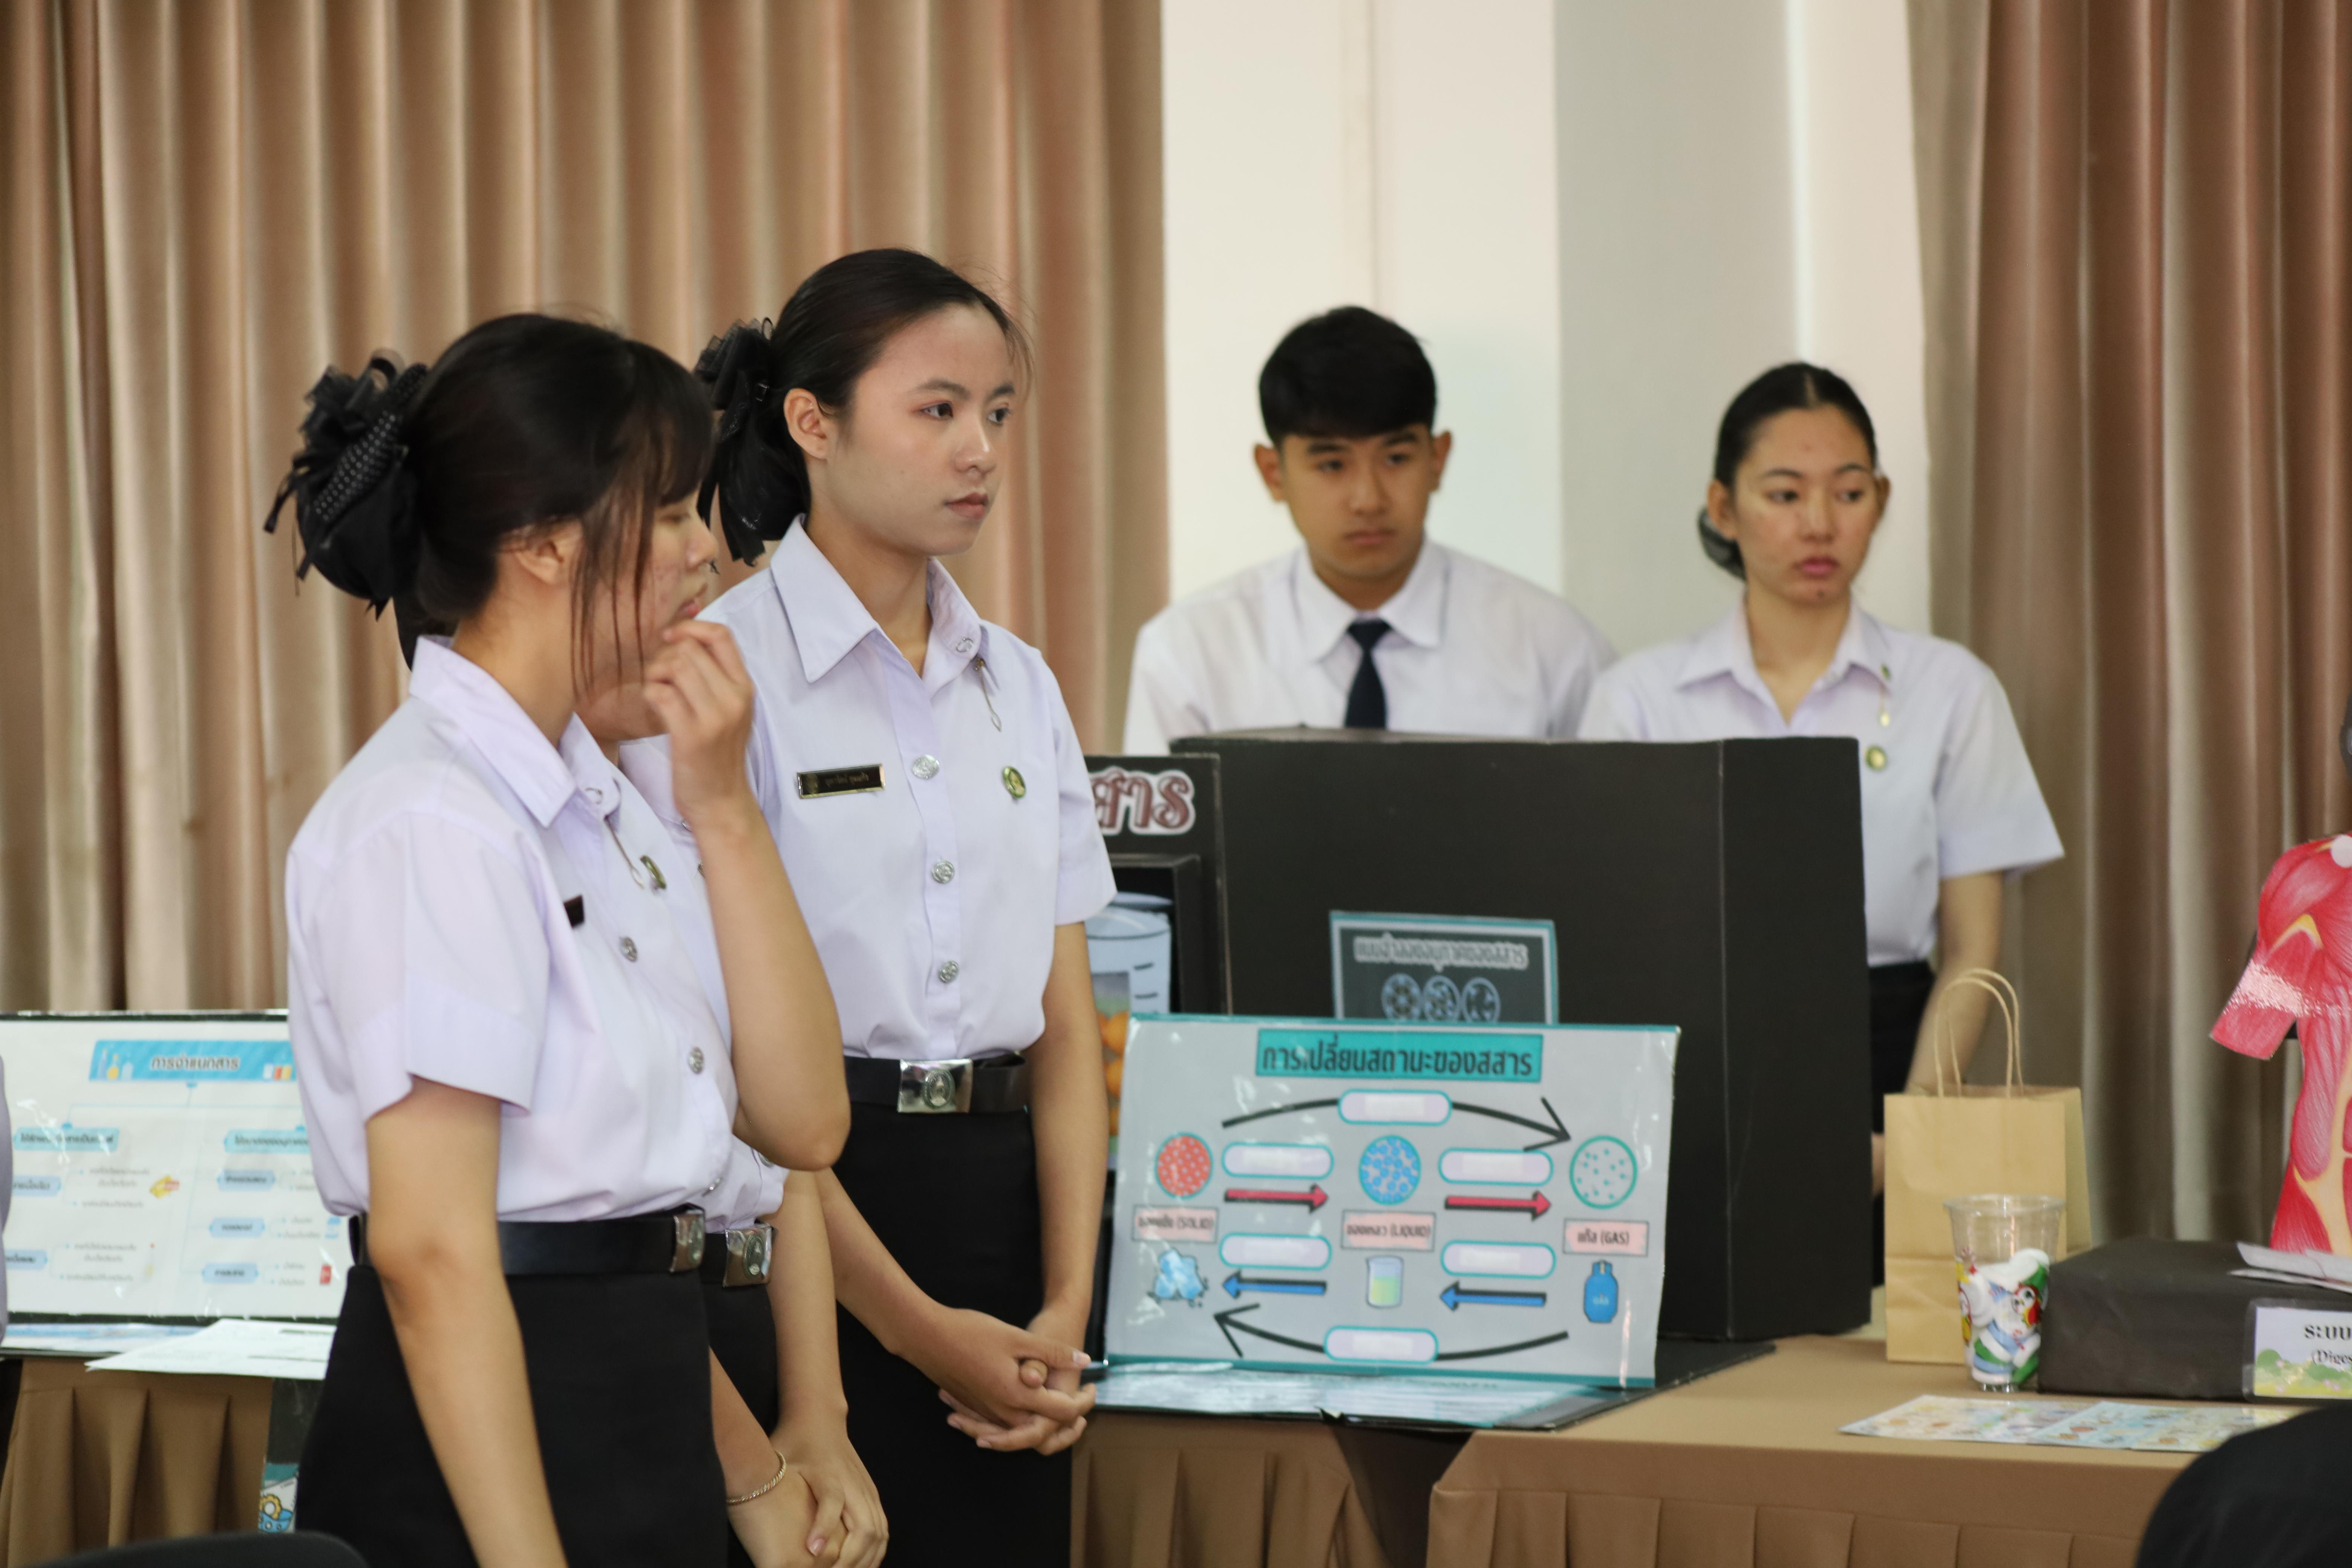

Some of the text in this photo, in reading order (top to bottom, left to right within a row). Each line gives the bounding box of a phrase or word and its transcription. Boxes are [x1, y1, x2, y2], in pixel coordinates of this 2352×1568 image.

[1263, 1032, 1533, 1076] การเปลี่ยนสถานะของสสาร
[1601, 1230, 1629, 1246] (GAS)
